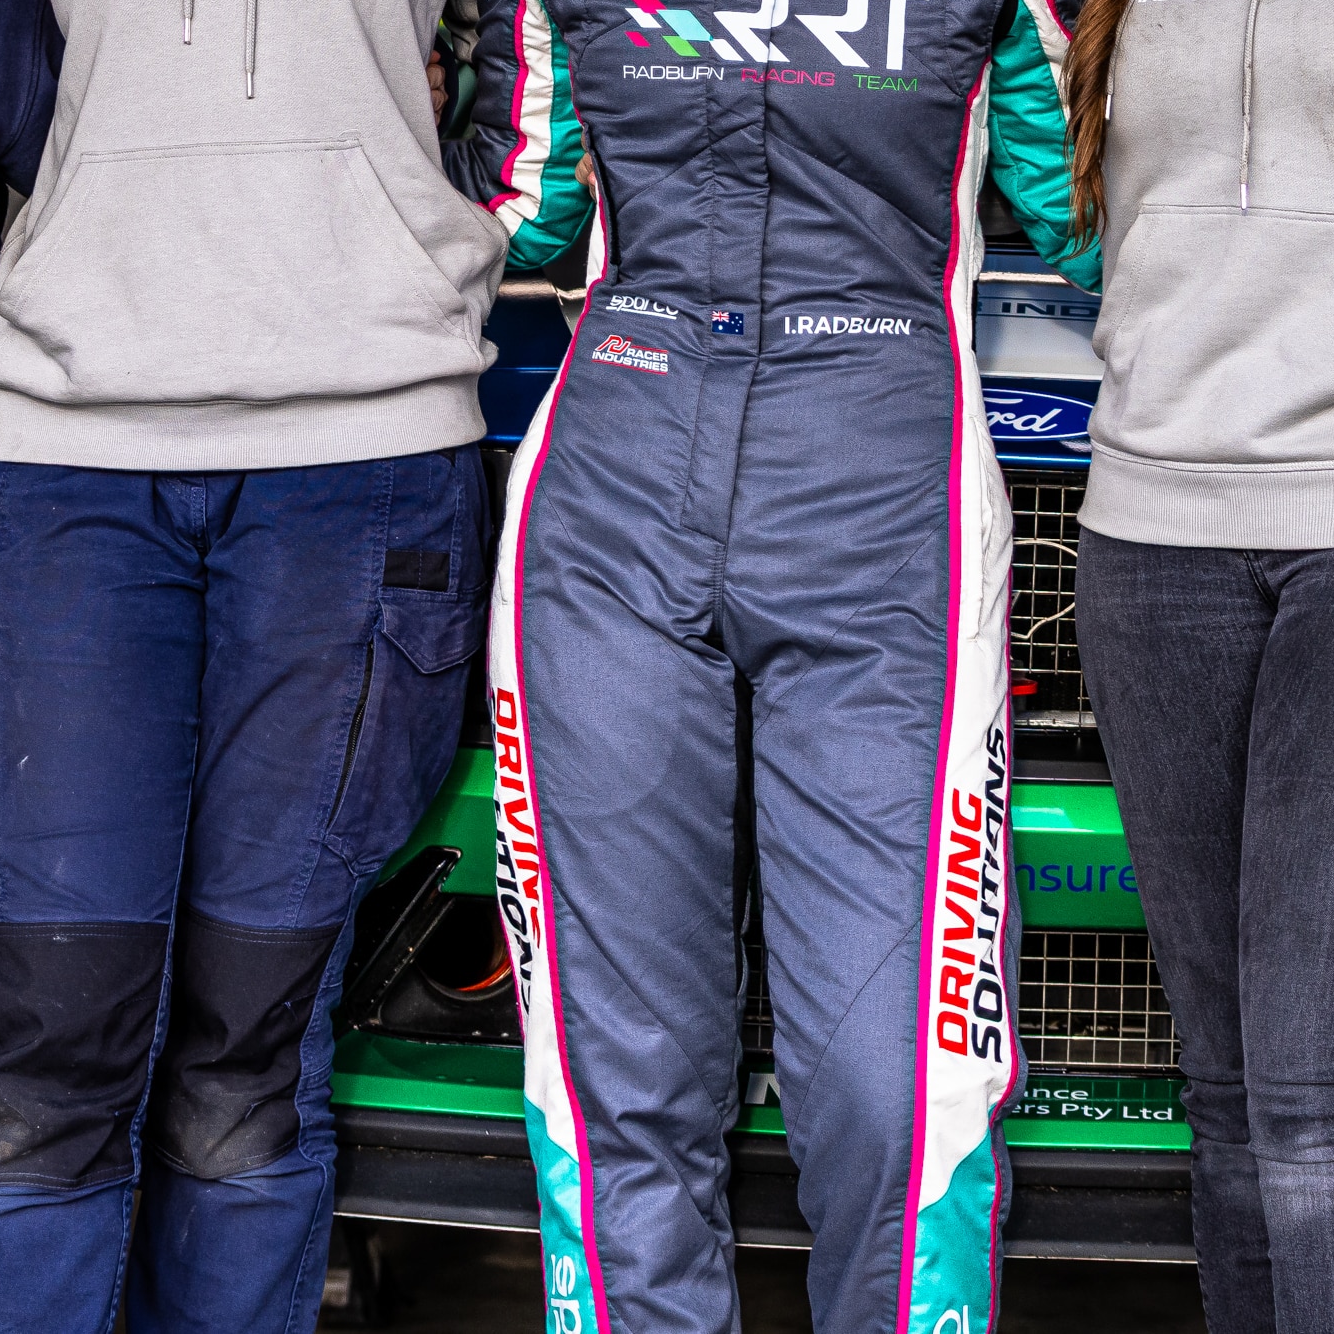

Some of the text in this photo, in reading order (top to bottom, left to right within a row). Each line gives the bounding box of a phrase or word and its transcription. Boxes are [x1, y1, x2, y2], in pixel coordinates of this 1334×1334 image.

[623, 65, 917, 91] RADBURN RACING TEAM
[784, 316, 912, 335] I.RADBURN
[592, 351, 669, 372] INDUSTRIES
[626, 348, 668, 362] RACER
[937, 787, 983, 1057] DRIVING
[1061, 1103, 1113, 1120] Pty
[1122, 1106, 1173, 1121] Ltd
